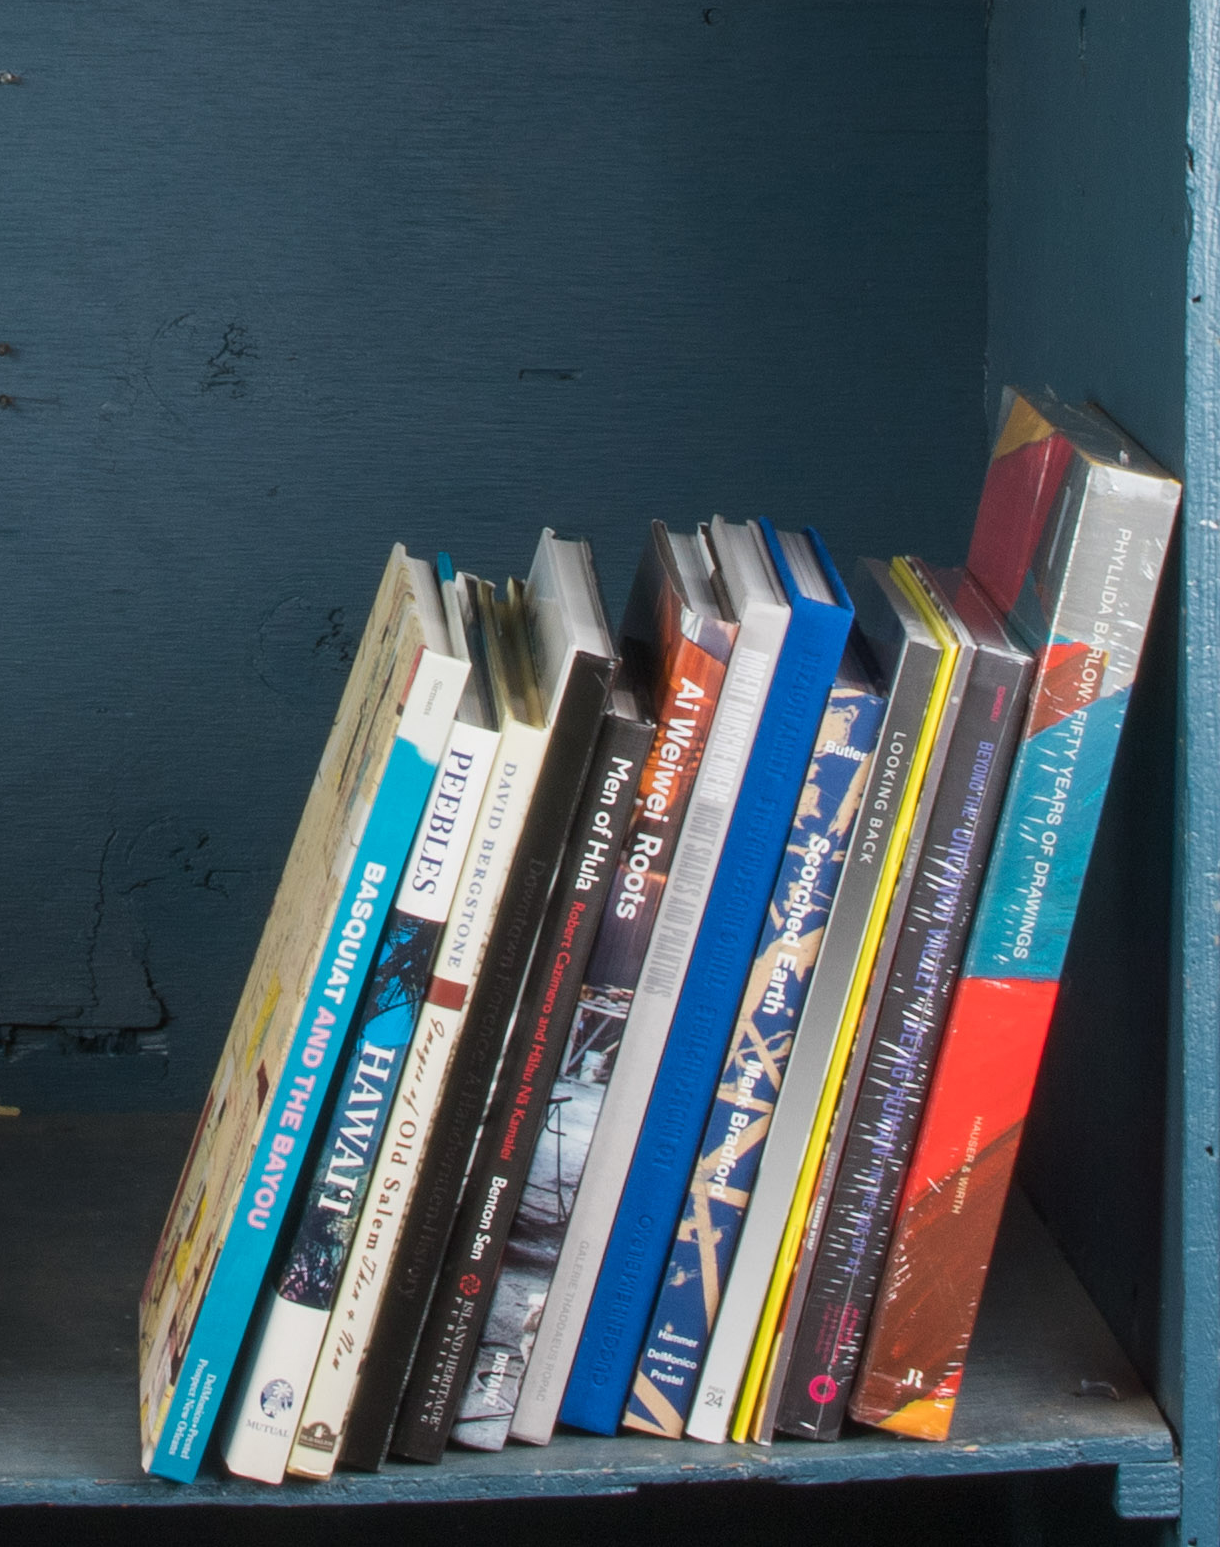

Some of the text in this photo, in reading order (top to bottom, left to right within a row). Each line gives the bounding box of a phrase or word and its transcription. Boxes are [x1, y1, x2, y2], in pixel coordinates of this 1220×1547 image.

[613, 676, 707, 923] Ai Weiwei Roots
[824, 740, 869, 762] Butler
[858, 730, 906, 866] LOOKING BACK
[1011, 526, 1132, 960] PHYLLIDA BARLOW: FIFTY YEARS OF DRAWINGS
[408, 746, 475, 897] PEEBLES
[445, 760, 518, 969] DAVID BERGSTONE
[573, 755, 633, 895] Men of Hula
[760, 833, 832, 1018] Scorched Earth
[244, 859, 387, 1231] BASQUIAT AND THE BAYOU
[709, 1056, 765, 1200] Mark Bradford
[950, 1114, 983, 1216] HAUSER & WIRTH
[468, 1174, 508, 1263] Benton Sen
[246, 1420, 290, 1438] MUTUAL
[705, 1391, 723, 1408] 24
